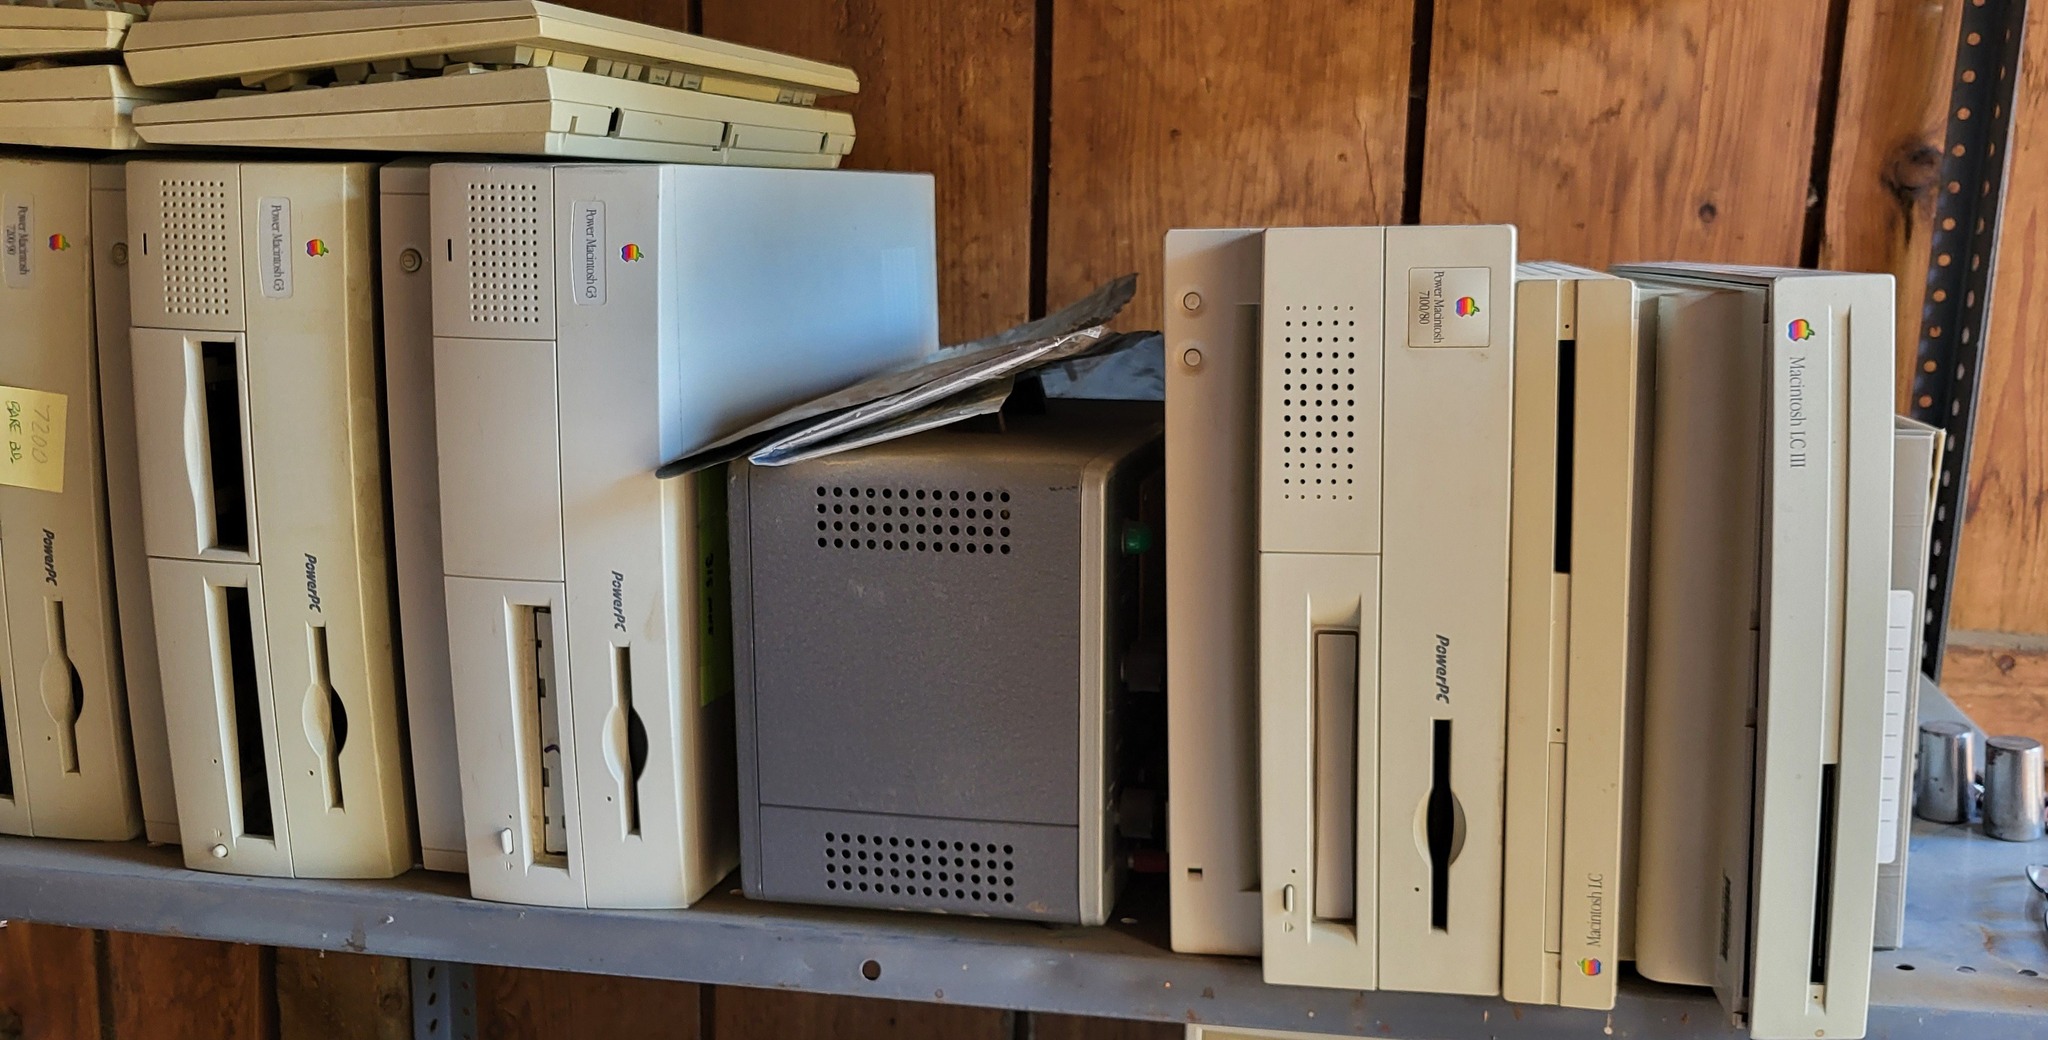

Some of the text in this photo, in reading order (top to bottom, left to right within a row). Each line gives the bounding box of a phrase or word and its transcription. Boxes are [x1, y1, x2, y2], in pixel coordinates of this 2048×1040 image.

[17, 205, 30, 275] Power Macintosh
[271, 204, 285, 291] Power Macintosh G3
[585, 208, 598, 299] Power Macintosh G3
[1418, 290, 1431, 325] 7100/80
[1433, 271, 1445, 344] Power Macintosh
[31, 405, 51, 464] 7200
[1789, 356, 1807, 468] Macintosh LC III
[42, 528, 58, 587] PowerPC
[304, 552, 322, 613] PowerPC
[611, 570, 627, 633] PowerPC
[1435, 633, 1450, 704] PowerPC
[1586, 873, 1603, 947] Macintosh LC
